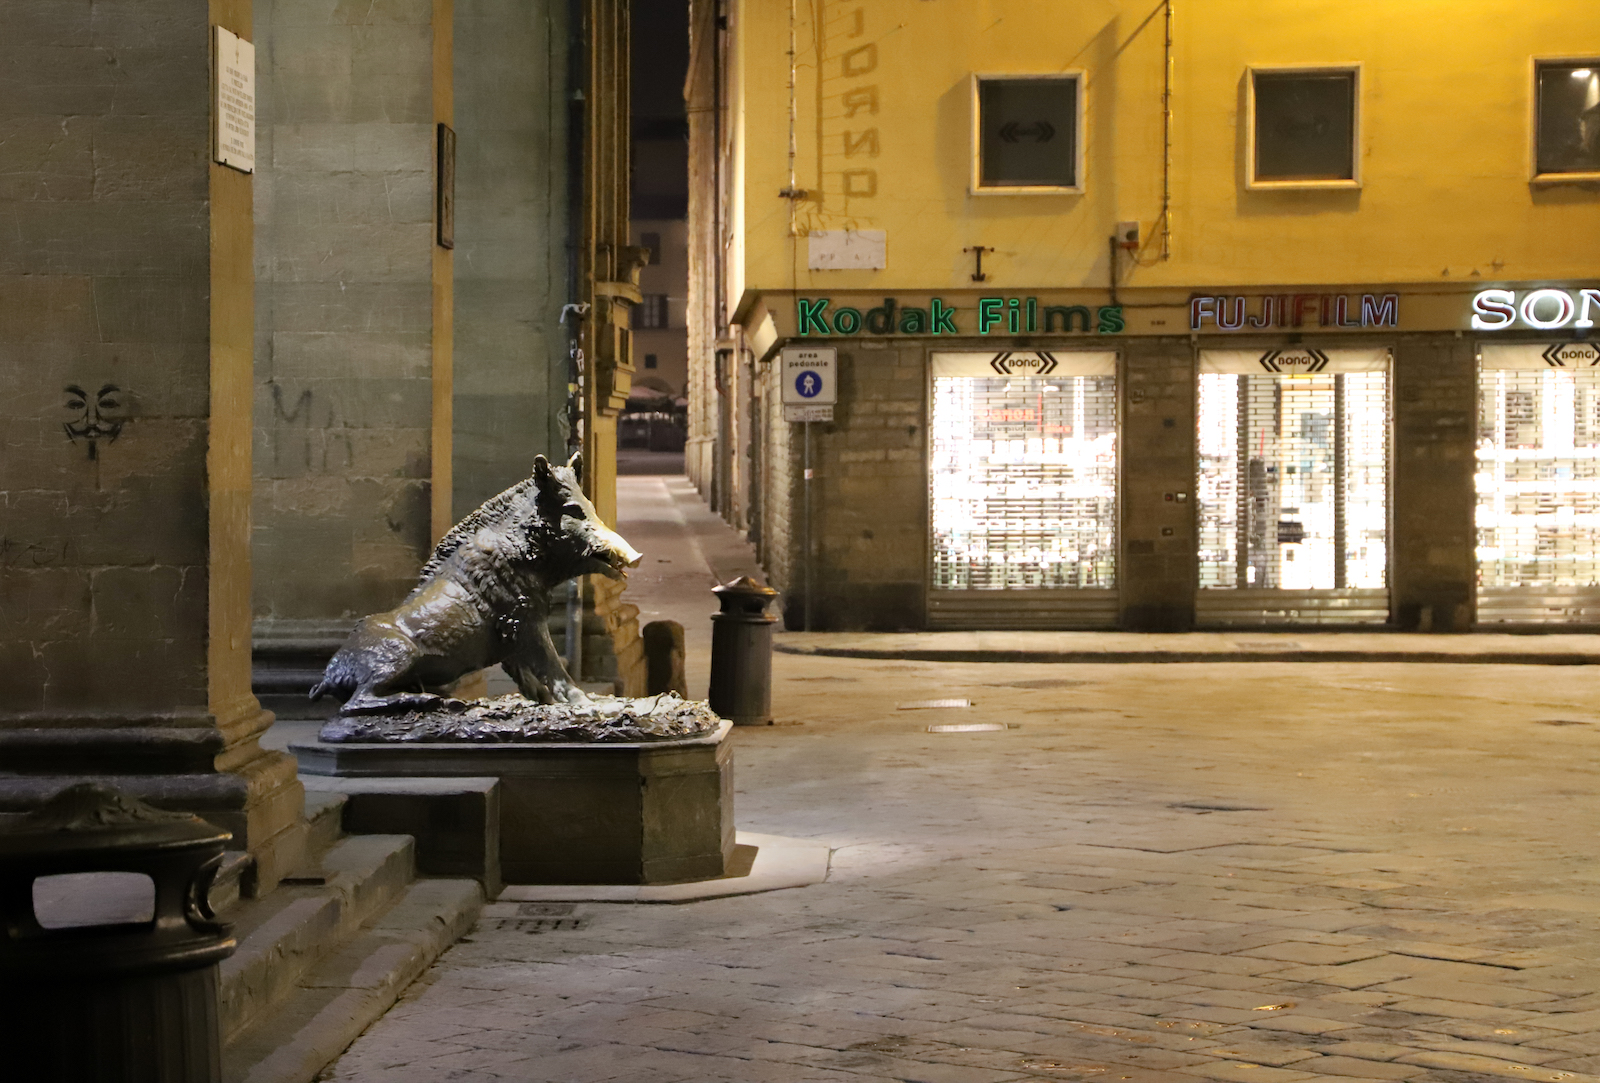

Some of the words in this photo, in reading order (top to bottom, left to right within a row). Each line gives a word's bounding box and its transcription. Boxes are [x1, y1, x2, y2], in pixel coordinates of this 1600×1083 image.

[799, 298, 958, 335] Kodak
[979, 298, 1125, 335] Films
[1190, 294, 1399, 331] FUJIFILM
[1561, 350, 1595, 359] BONGI
[788, 360, 829, 368] pedonale
[1008, 357, 1041, 368] BONGI
[1278, 356, 1311, 366] BONGI
